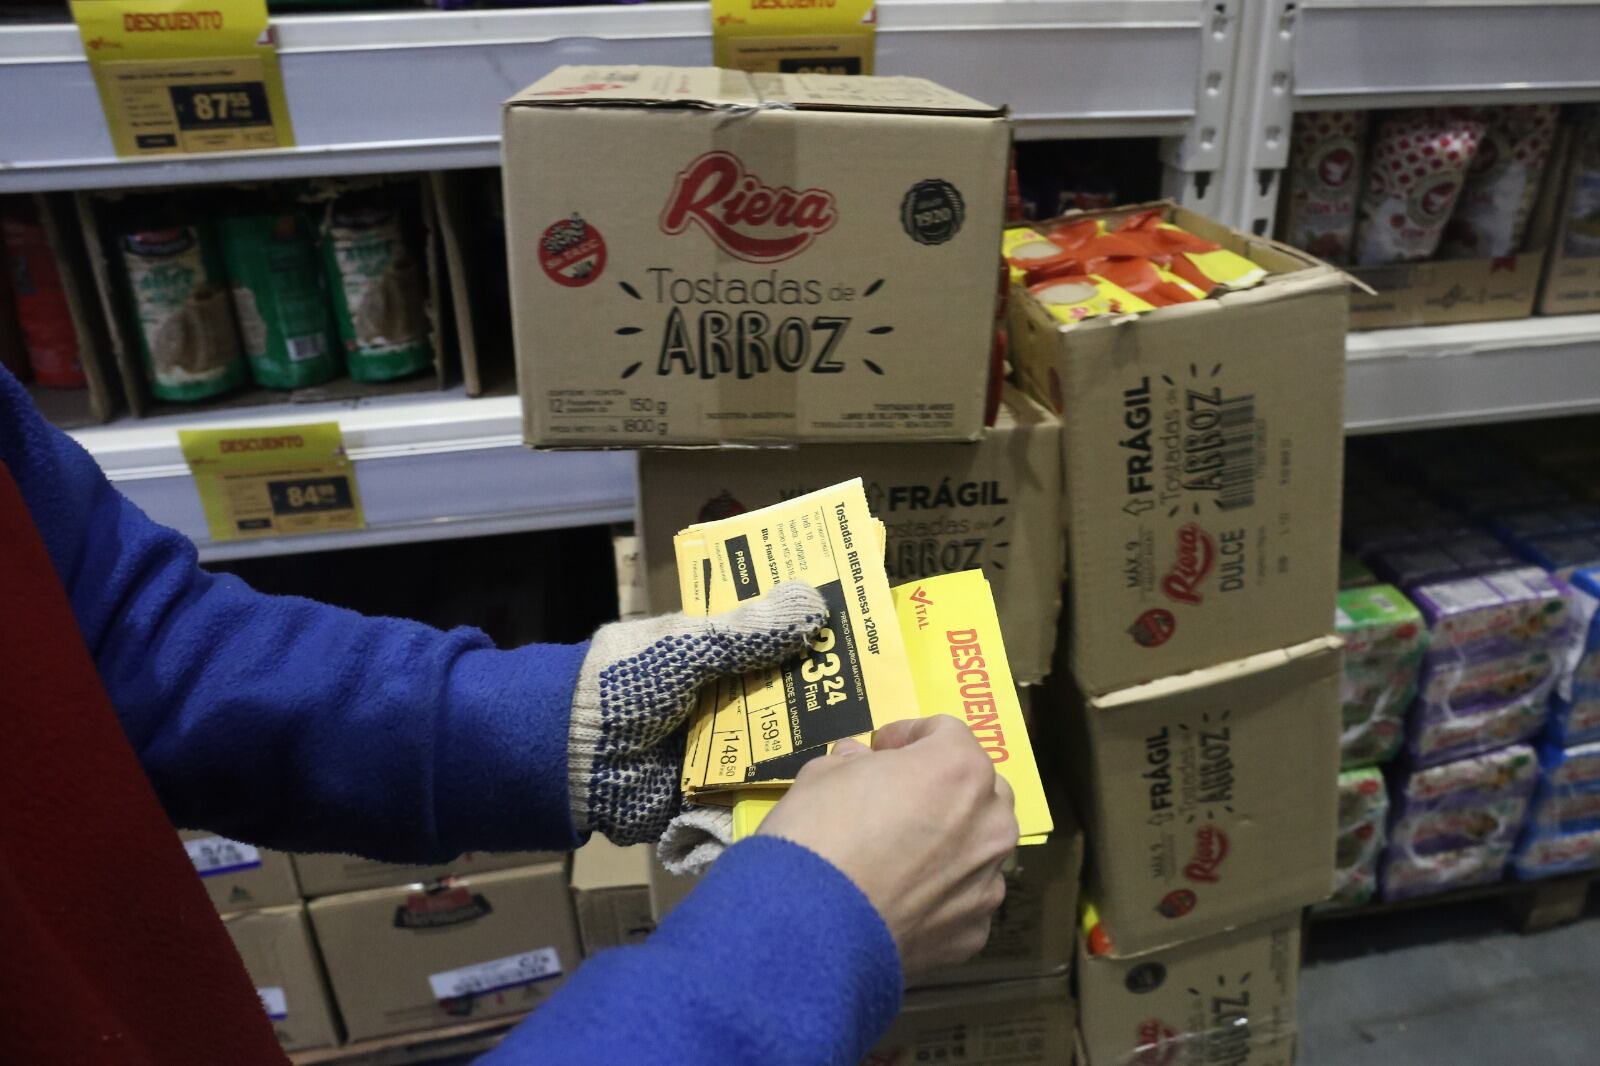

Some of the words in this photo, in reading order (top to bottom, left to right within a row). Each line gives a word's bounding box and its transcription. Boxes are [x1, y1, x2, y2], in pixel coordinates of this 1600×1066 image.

[123, 11, 223, 32] DESCUENTO
[193, 92, 230, 120] 87
[660, 150, 838, 263] Riera
[646, 267, 823, 306] Tostadas
[827, 281, 857, 302] de
[656, 305, 852, 380] ARROZ
[219, 435, 304, 454] DESCUENTO
[1118, 375, 1154, 495] FRÁGIL
[1183, 386, 1226, 492] ARROZ
[1158, 409, 1182, 505] Tostadas
[286, 485, 319, 508] 84
[888, 477, 1009, 512] FRÁGIL
[761, 528, 769, 543] Bto.
[766, 543, 775, 562] Final
[887, 516, 969, 539] ostadas
[734, 550, 751, 585] PROMO
[886, 537, 986, 577] RROZ
[1160, 521, 1216, 606] Riera
[1219, 528, 1246, 592] DULCE
[834, 501, 853, 550] Tostadas
[847, 550, 864, 584] RIERA
[856, 585, 870, 616] mesa
[864, 617, 881, 656] x200gr
[909, 586, 934, 630] VITAL
[839, 611, 850, 635] PRECIO
[845, 635, 857, 664] UNITARIO
[851, 663, 865, 702] MAYORISTA
[785, 672, 796, 698] DESDE
[804, 683, 821, 712] Final
[790, 707, 803, 746] UNIDADES
[1142, 725, 1173, 811] FRÁGIL
[1183, 824, 1231, 884] Riera
